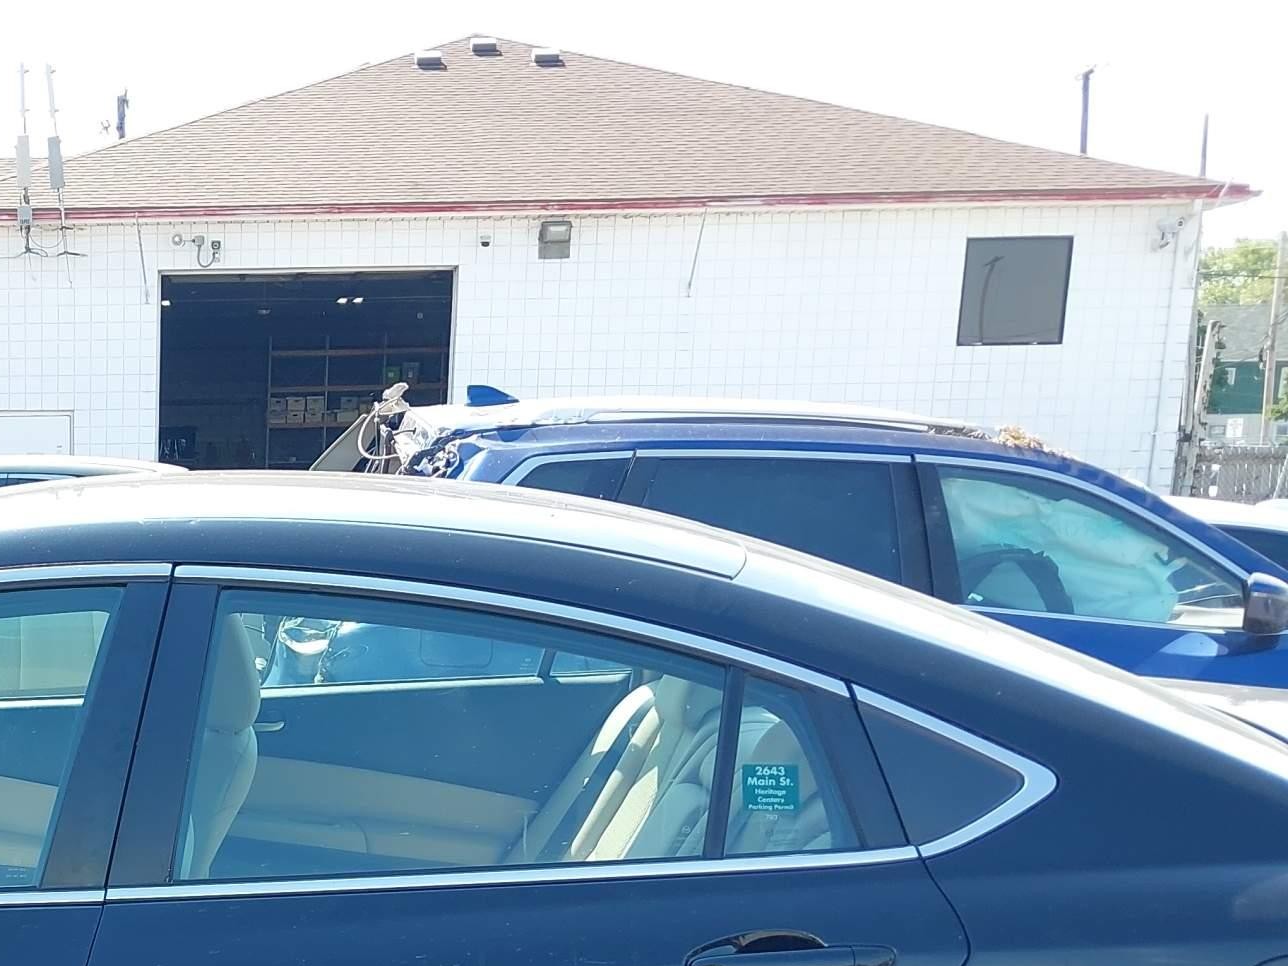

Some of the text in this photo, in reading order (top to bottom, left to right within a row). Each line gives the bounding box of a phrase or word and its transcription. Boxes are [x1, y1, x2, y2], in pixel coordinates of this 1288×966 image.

[755, 766, 785, 776] 2643
[747, 776, 794, 786] Main St.
[754, 788, 786, 797] Heritage
